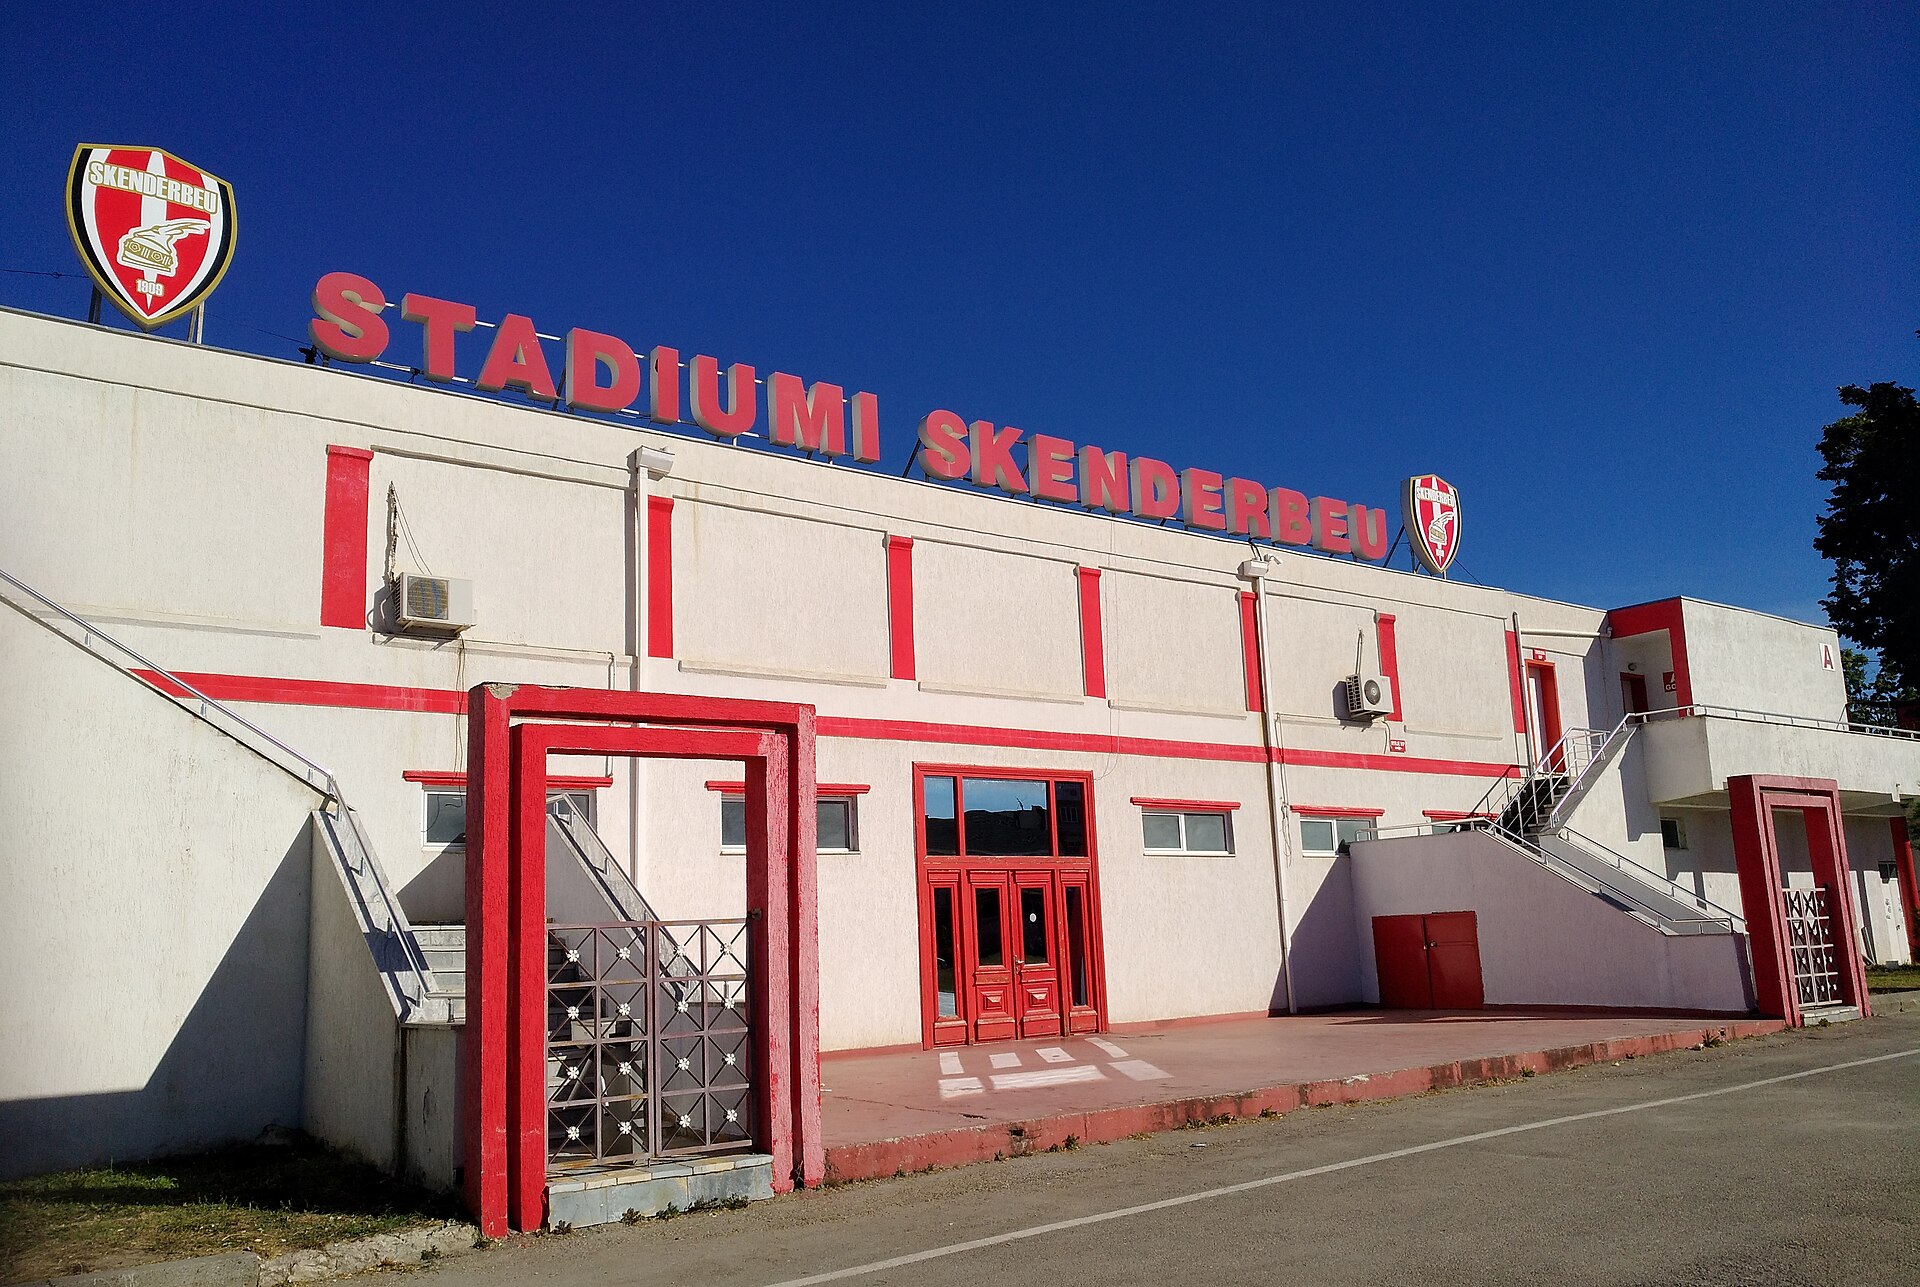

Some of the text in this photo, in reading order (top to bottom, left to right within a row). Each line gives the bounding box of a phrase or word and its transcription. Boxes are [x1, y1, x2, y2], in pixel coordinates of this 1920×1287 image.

[88, 161, 218, 215] SKENDERBEU
[308, 272, 1387, 561] STADIUMI SKENDERBEU
[1823, 644, 1834, 670] A
